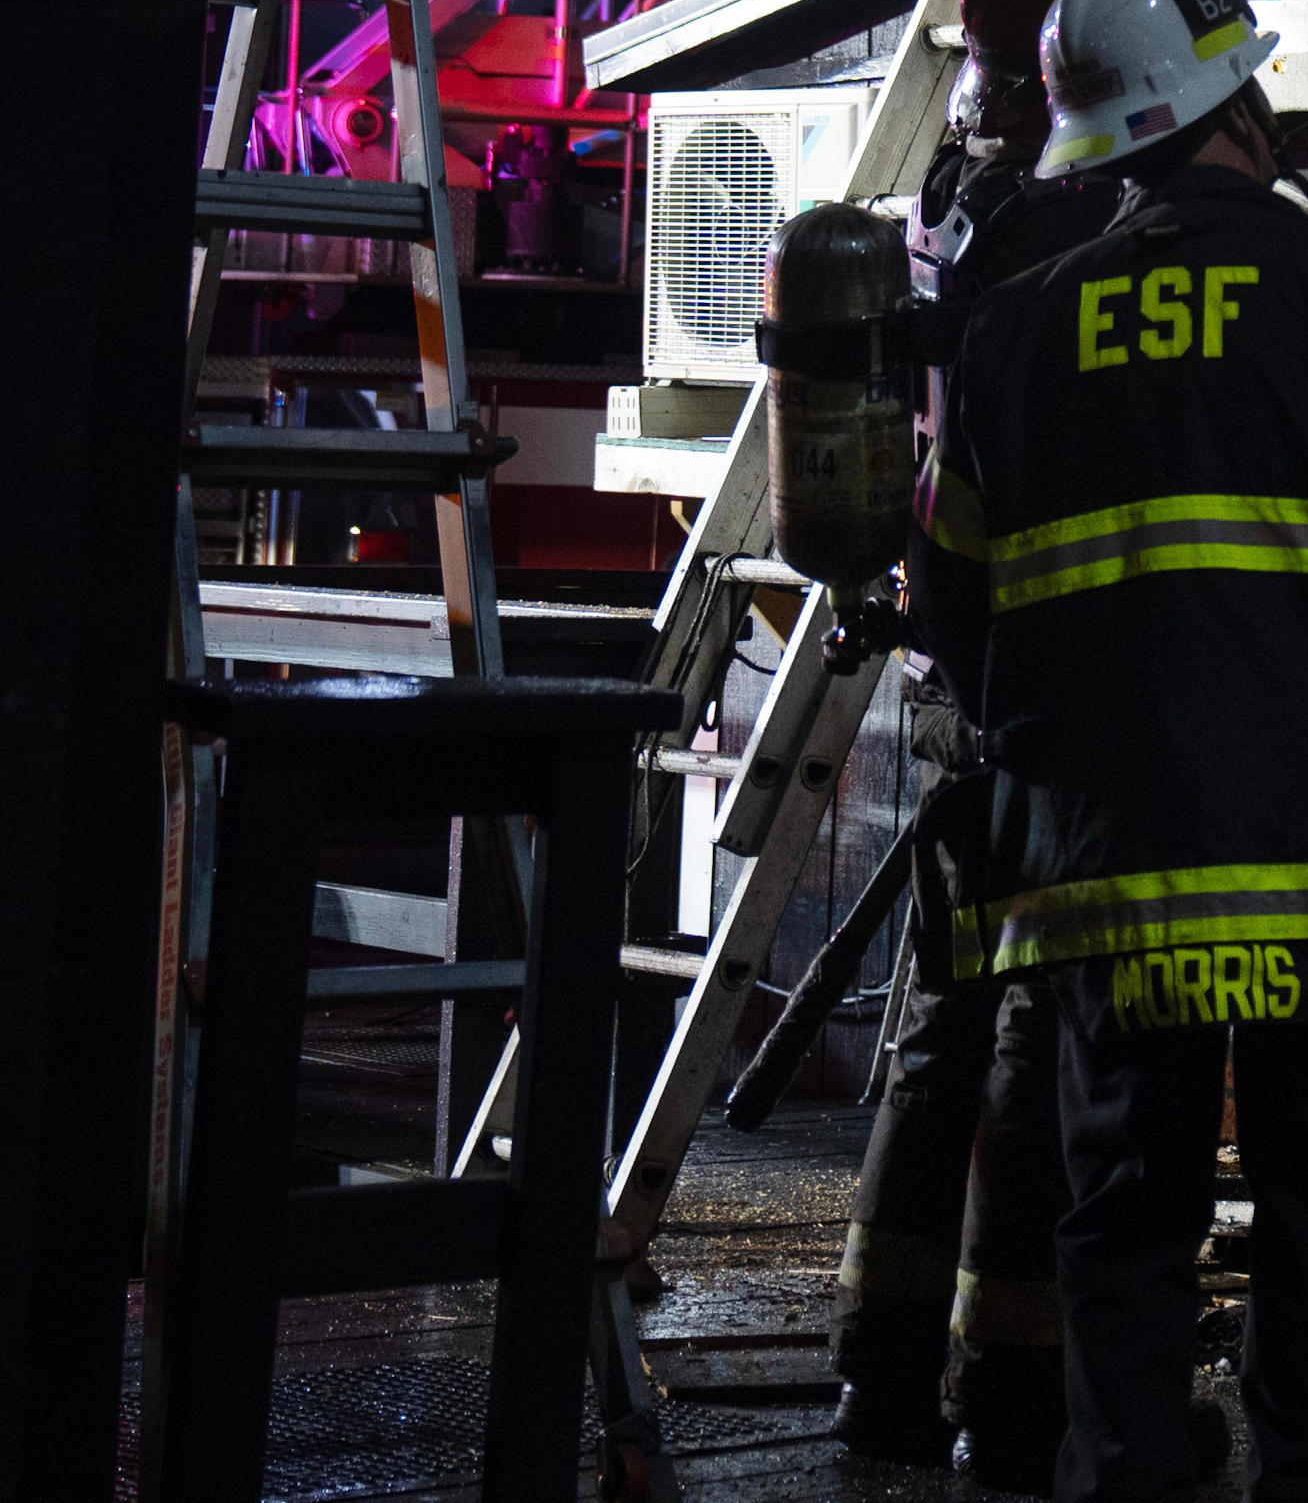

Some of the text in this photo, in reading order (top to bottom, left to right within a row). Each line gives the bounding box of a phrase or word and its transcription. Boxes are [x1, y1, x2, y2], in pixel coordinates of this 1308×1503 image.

[1079, 266, 1259, 372] ESF
[153, 724, 186, 1188] ittle Giant Ladder Systems
[1112, 943, 1300, 1032] MORRIS
